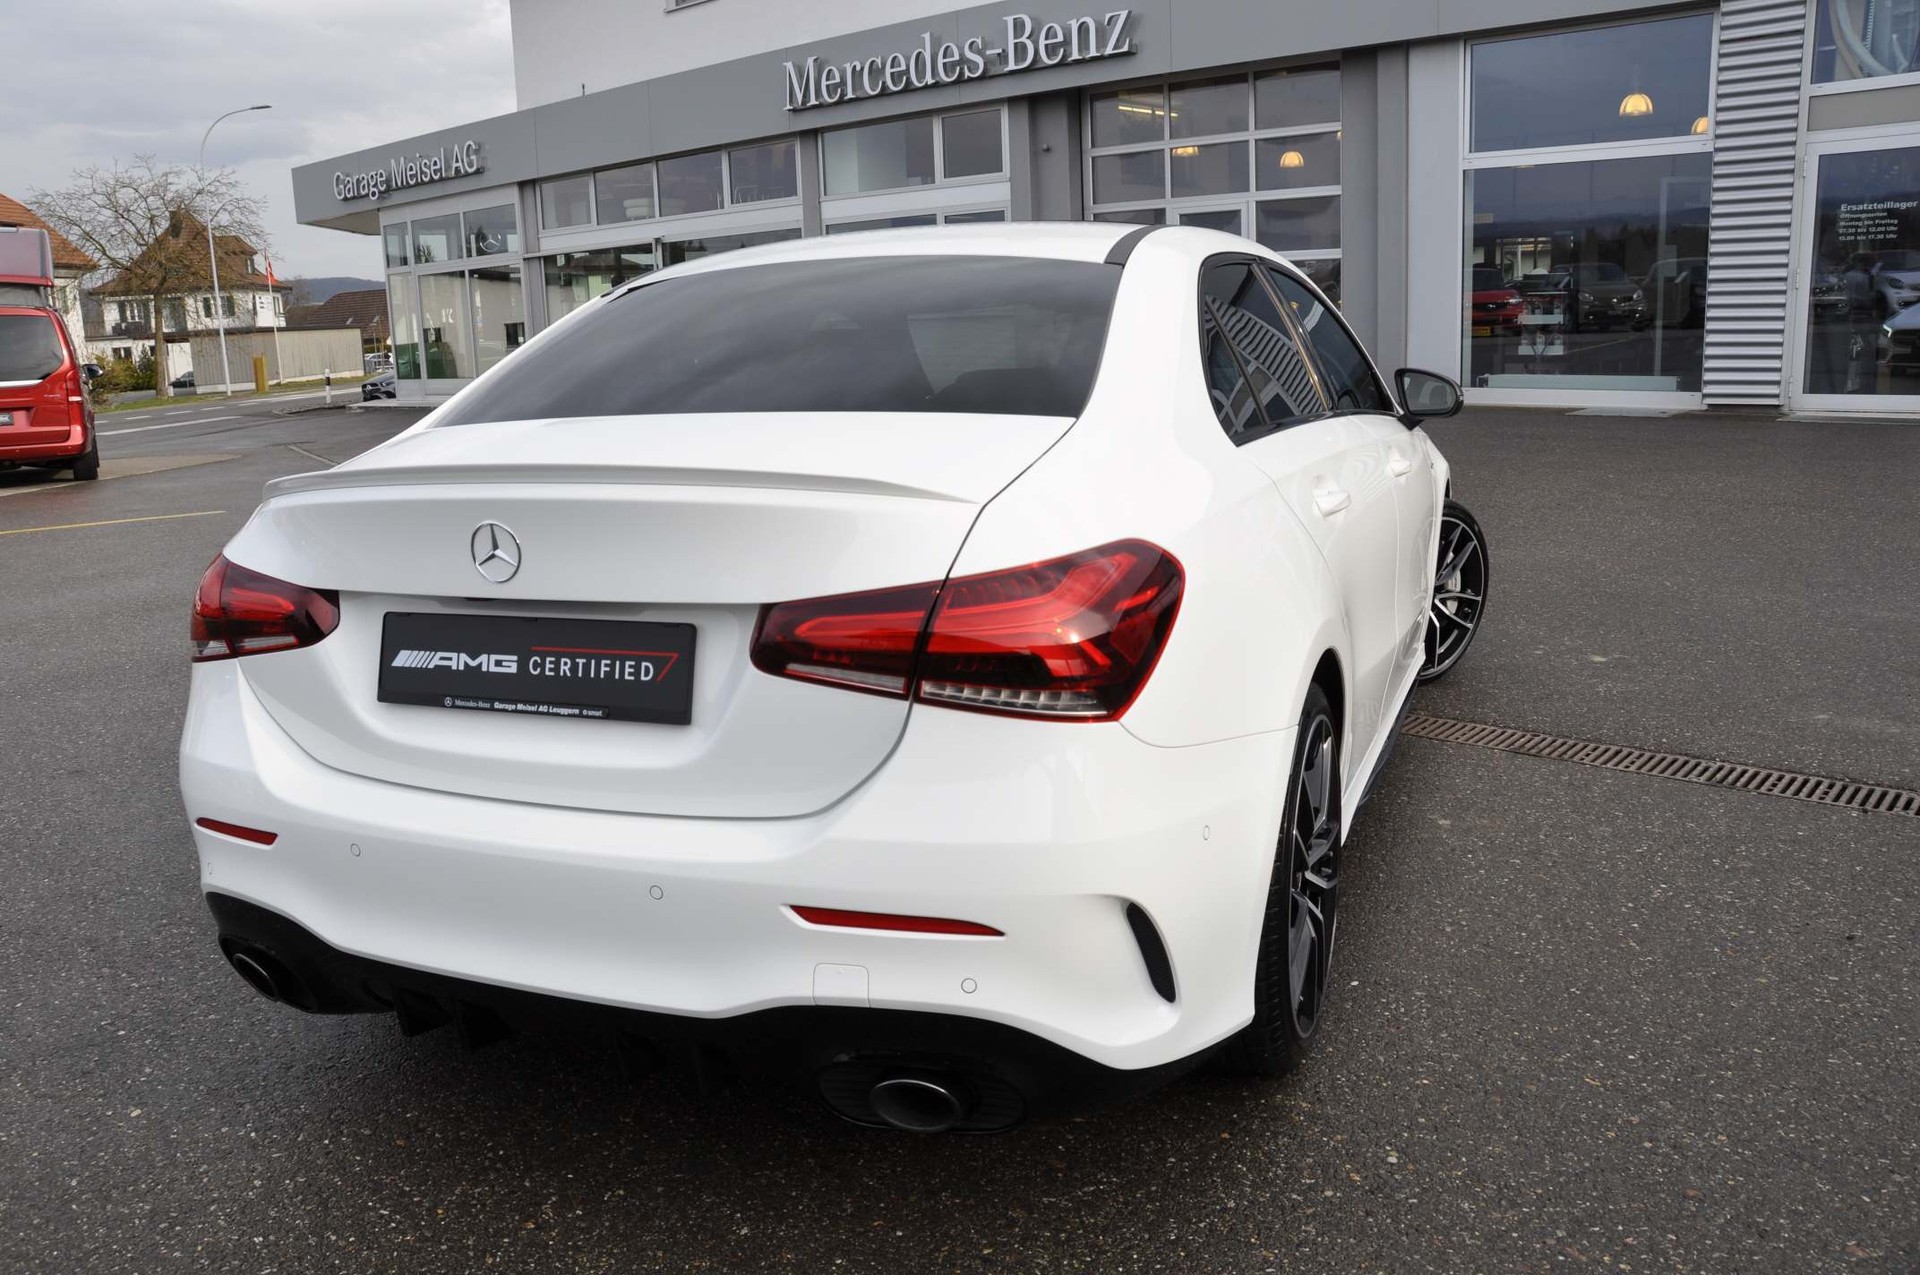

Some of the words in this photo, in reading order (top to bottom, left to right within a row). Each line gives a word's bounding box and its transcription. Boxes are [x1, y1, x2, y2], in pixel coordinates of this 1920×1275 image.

[783, 9, 1133, 111] Mercedes-Benz
[333, 169, 386, 200] Garage
[391, 148, 445, 188] Meisel
[451, 140, 477, 176] AG
[1841, 201, 1918, 211] Ersatzteillager
[430, 651, 518, 673] AMG
[529, 656, 654, 681] CERTIFIED
[494, 701, 516, 710] Garage
[517, 703, 538, 711] Meisel
[538, 704, 548, 712] AG
